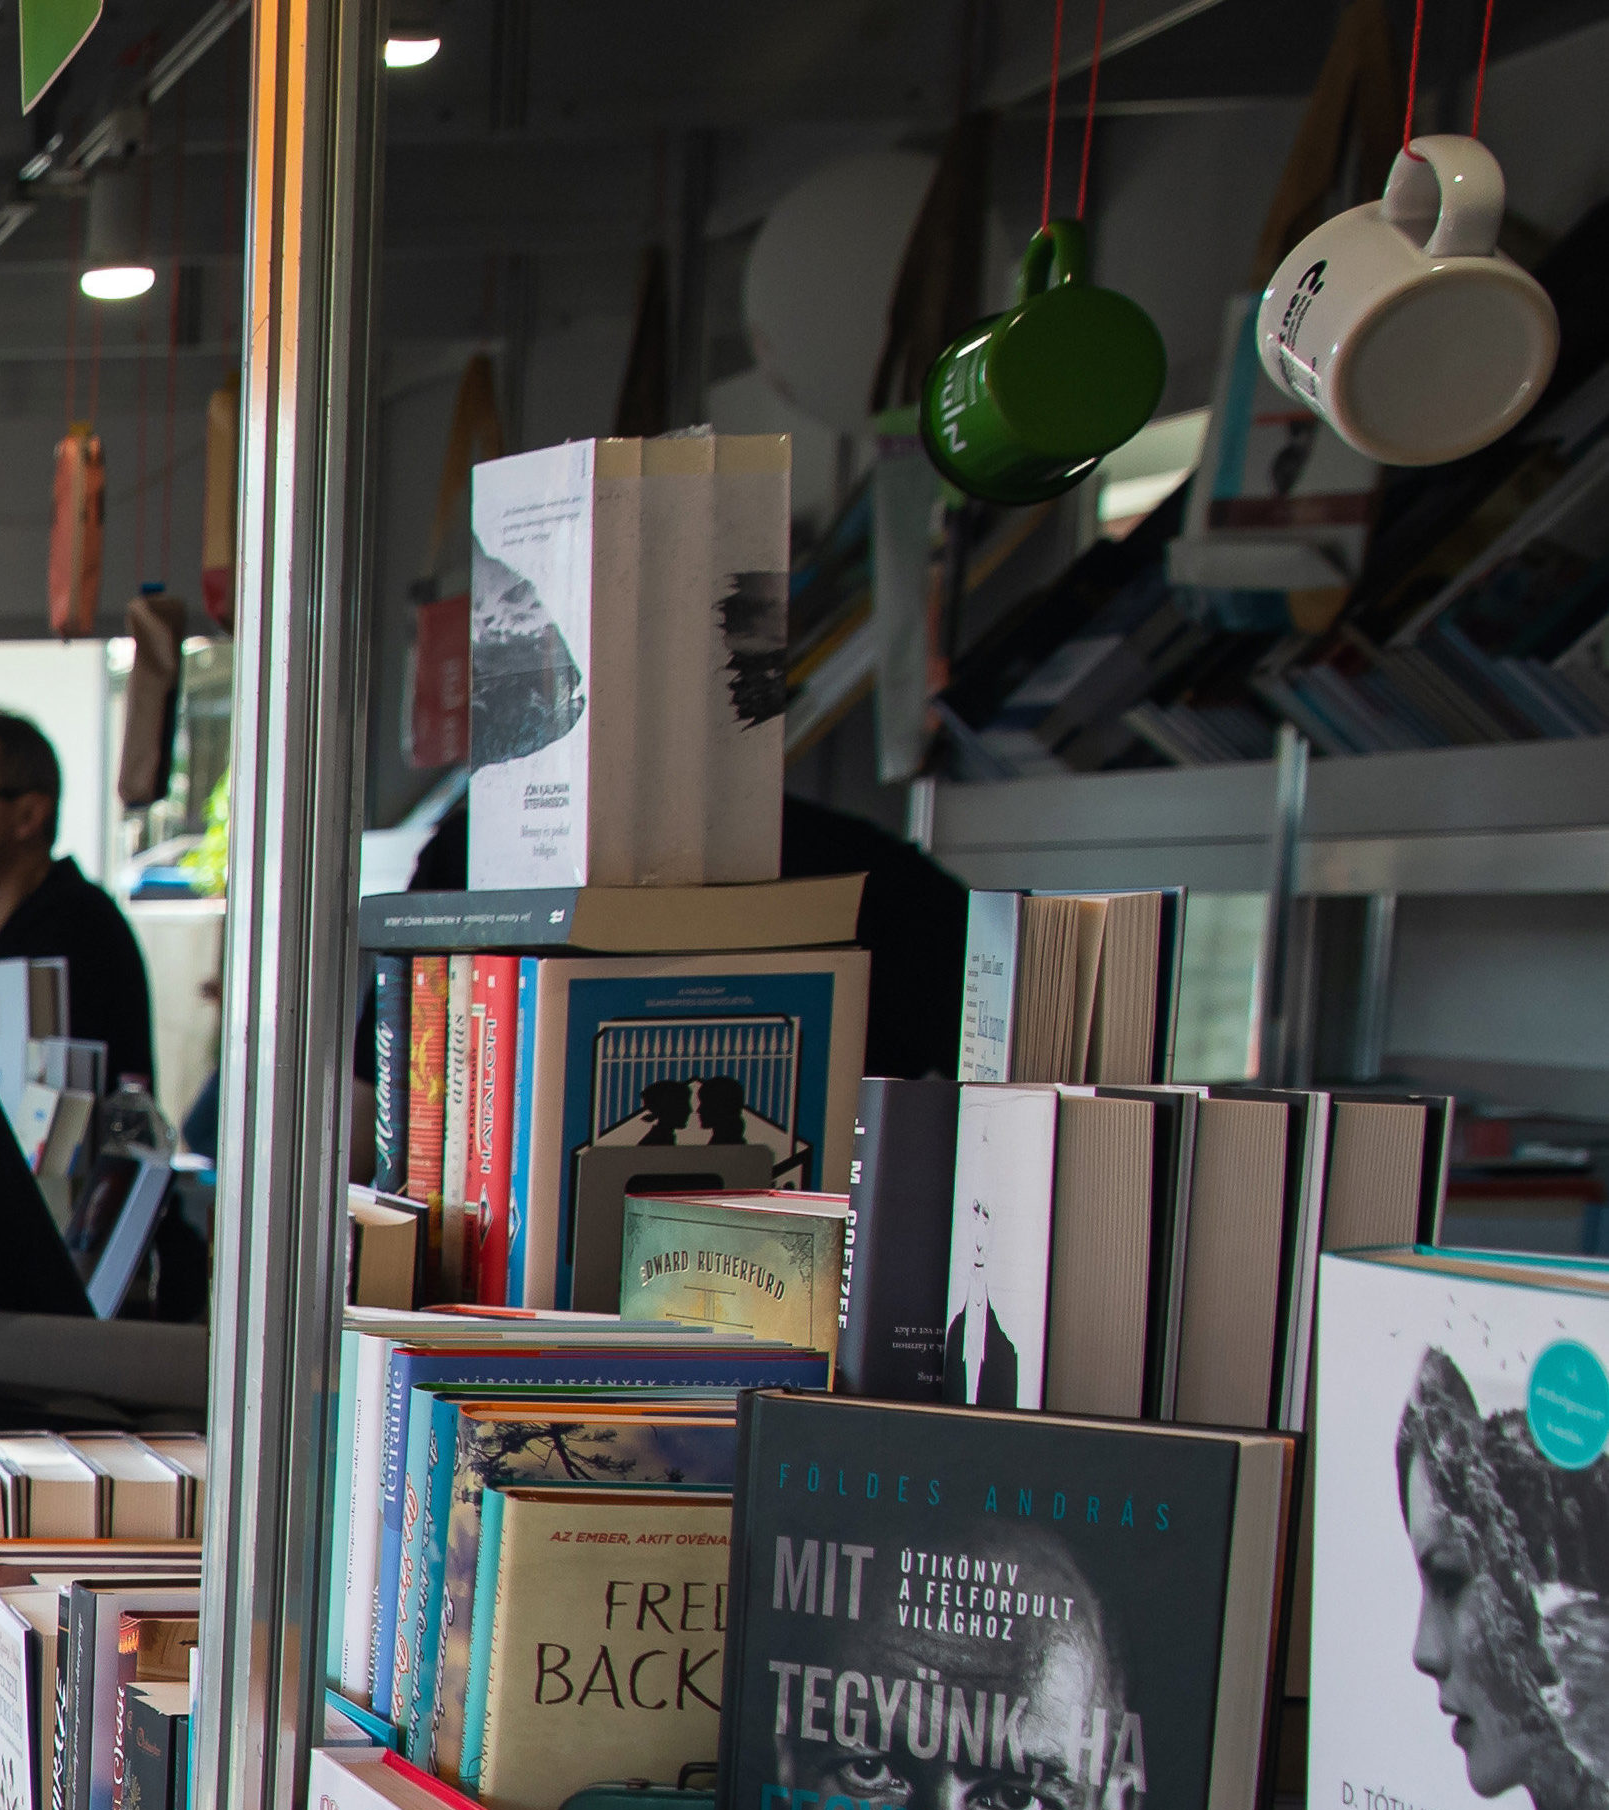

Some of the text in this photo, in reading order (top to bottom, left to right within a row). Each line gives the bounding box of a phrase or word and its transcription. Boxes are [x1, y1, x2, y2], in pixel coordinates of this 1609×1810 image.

[697, 1249, 785, 1302] RUTHERFURD
[778, 1462, 1171, 1531] FÖLDES ANDRÁS
[636, 1531, 672, 1546] AKIT
[772, 1535, 874, 1621] MIT
[899, 1547, 1021, 1588] ÚTIKÖNYV
[604, 1580, 729, 1634] FRED
[898, 1601, 1014, 1642] VILÁGHOZ
[899, 1577, 1075, 1622] A FELFORDULT
[533, 1641, 723, 1711] BACK
[1075, 1704, 1148, 1794] HA
